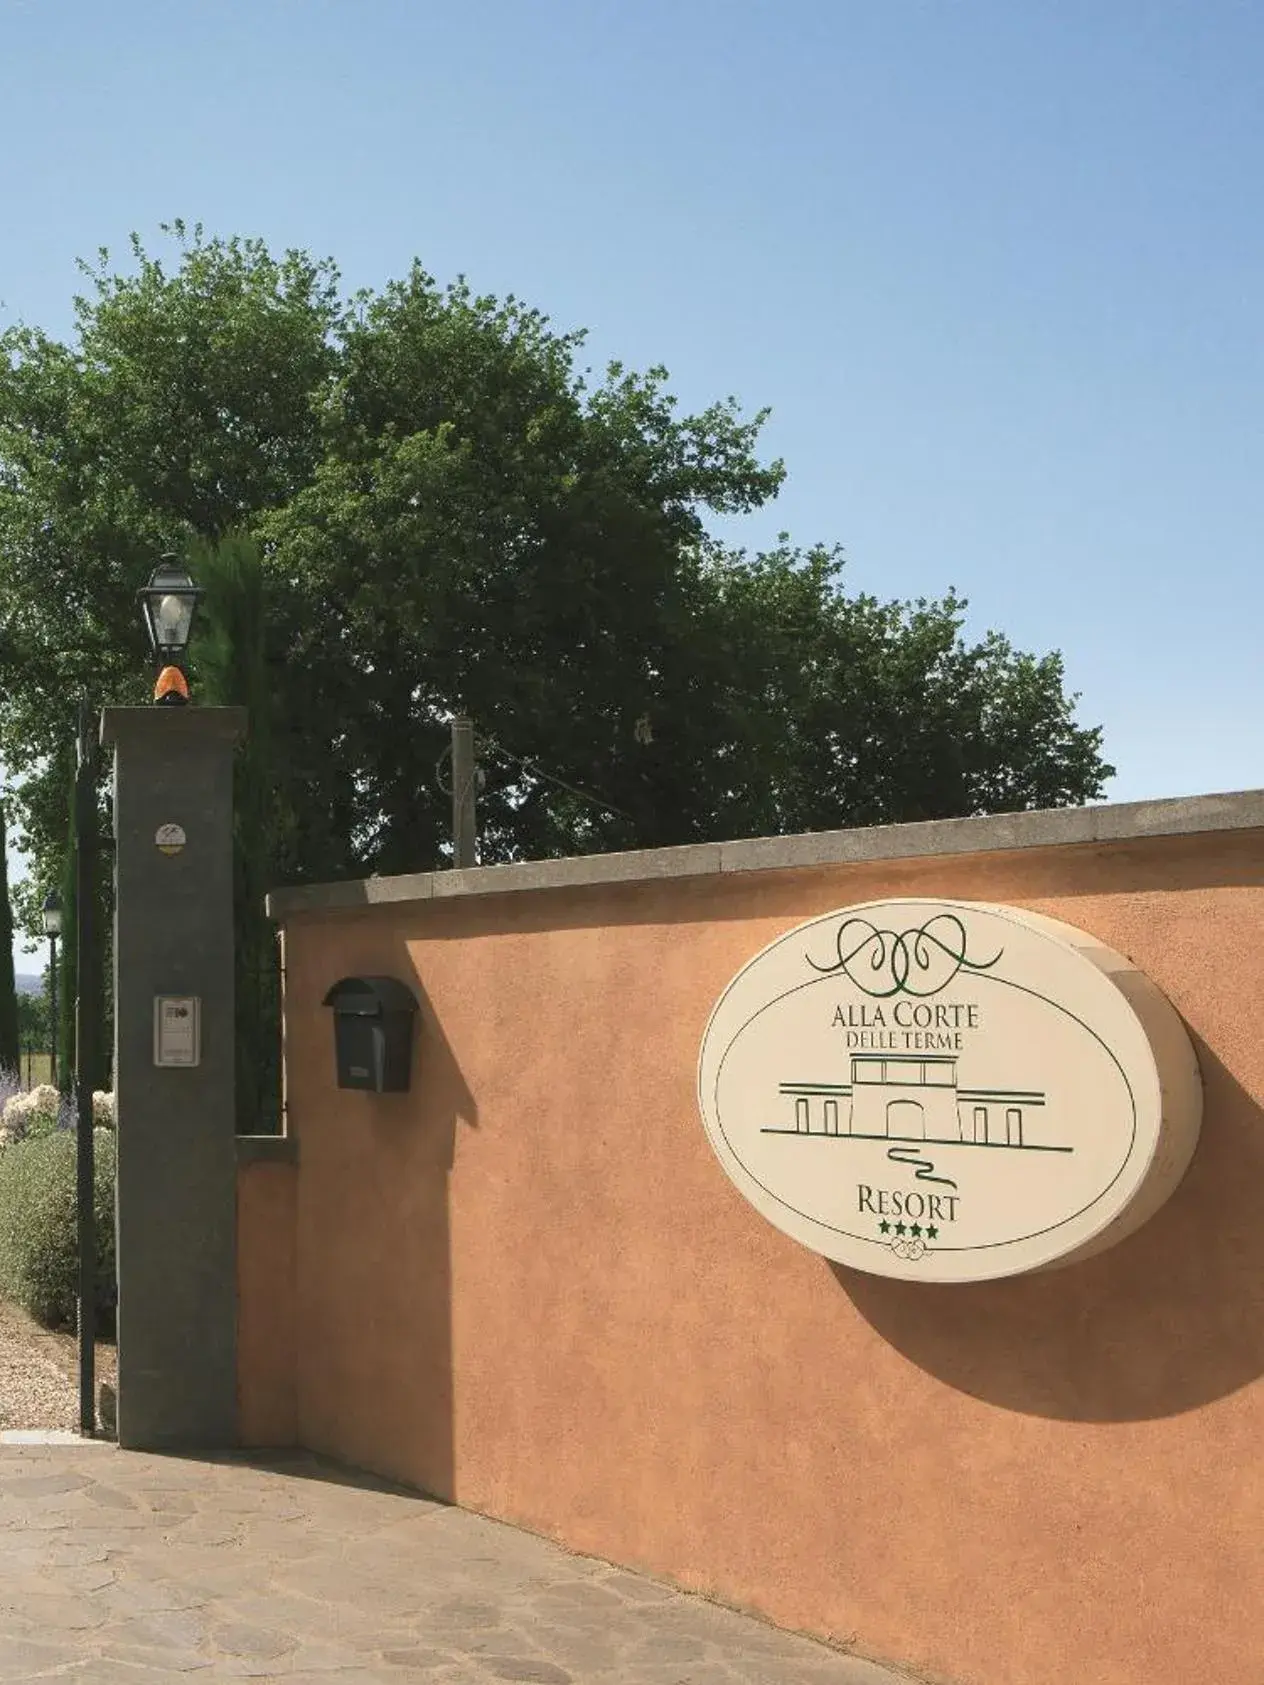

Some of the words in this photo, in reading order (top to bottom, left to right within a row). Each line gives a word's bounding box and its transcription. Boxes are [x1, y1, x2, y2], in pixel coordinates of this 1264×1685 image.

[832, 1003, 887, 1027] ALLA
[893, 1000, 979, 1028] CORTE
[846, 1030, 897, 1049] DELLE
[901, 1031, 964, 1050] TERME
[856, 1184, 960, 1221] RESORT
